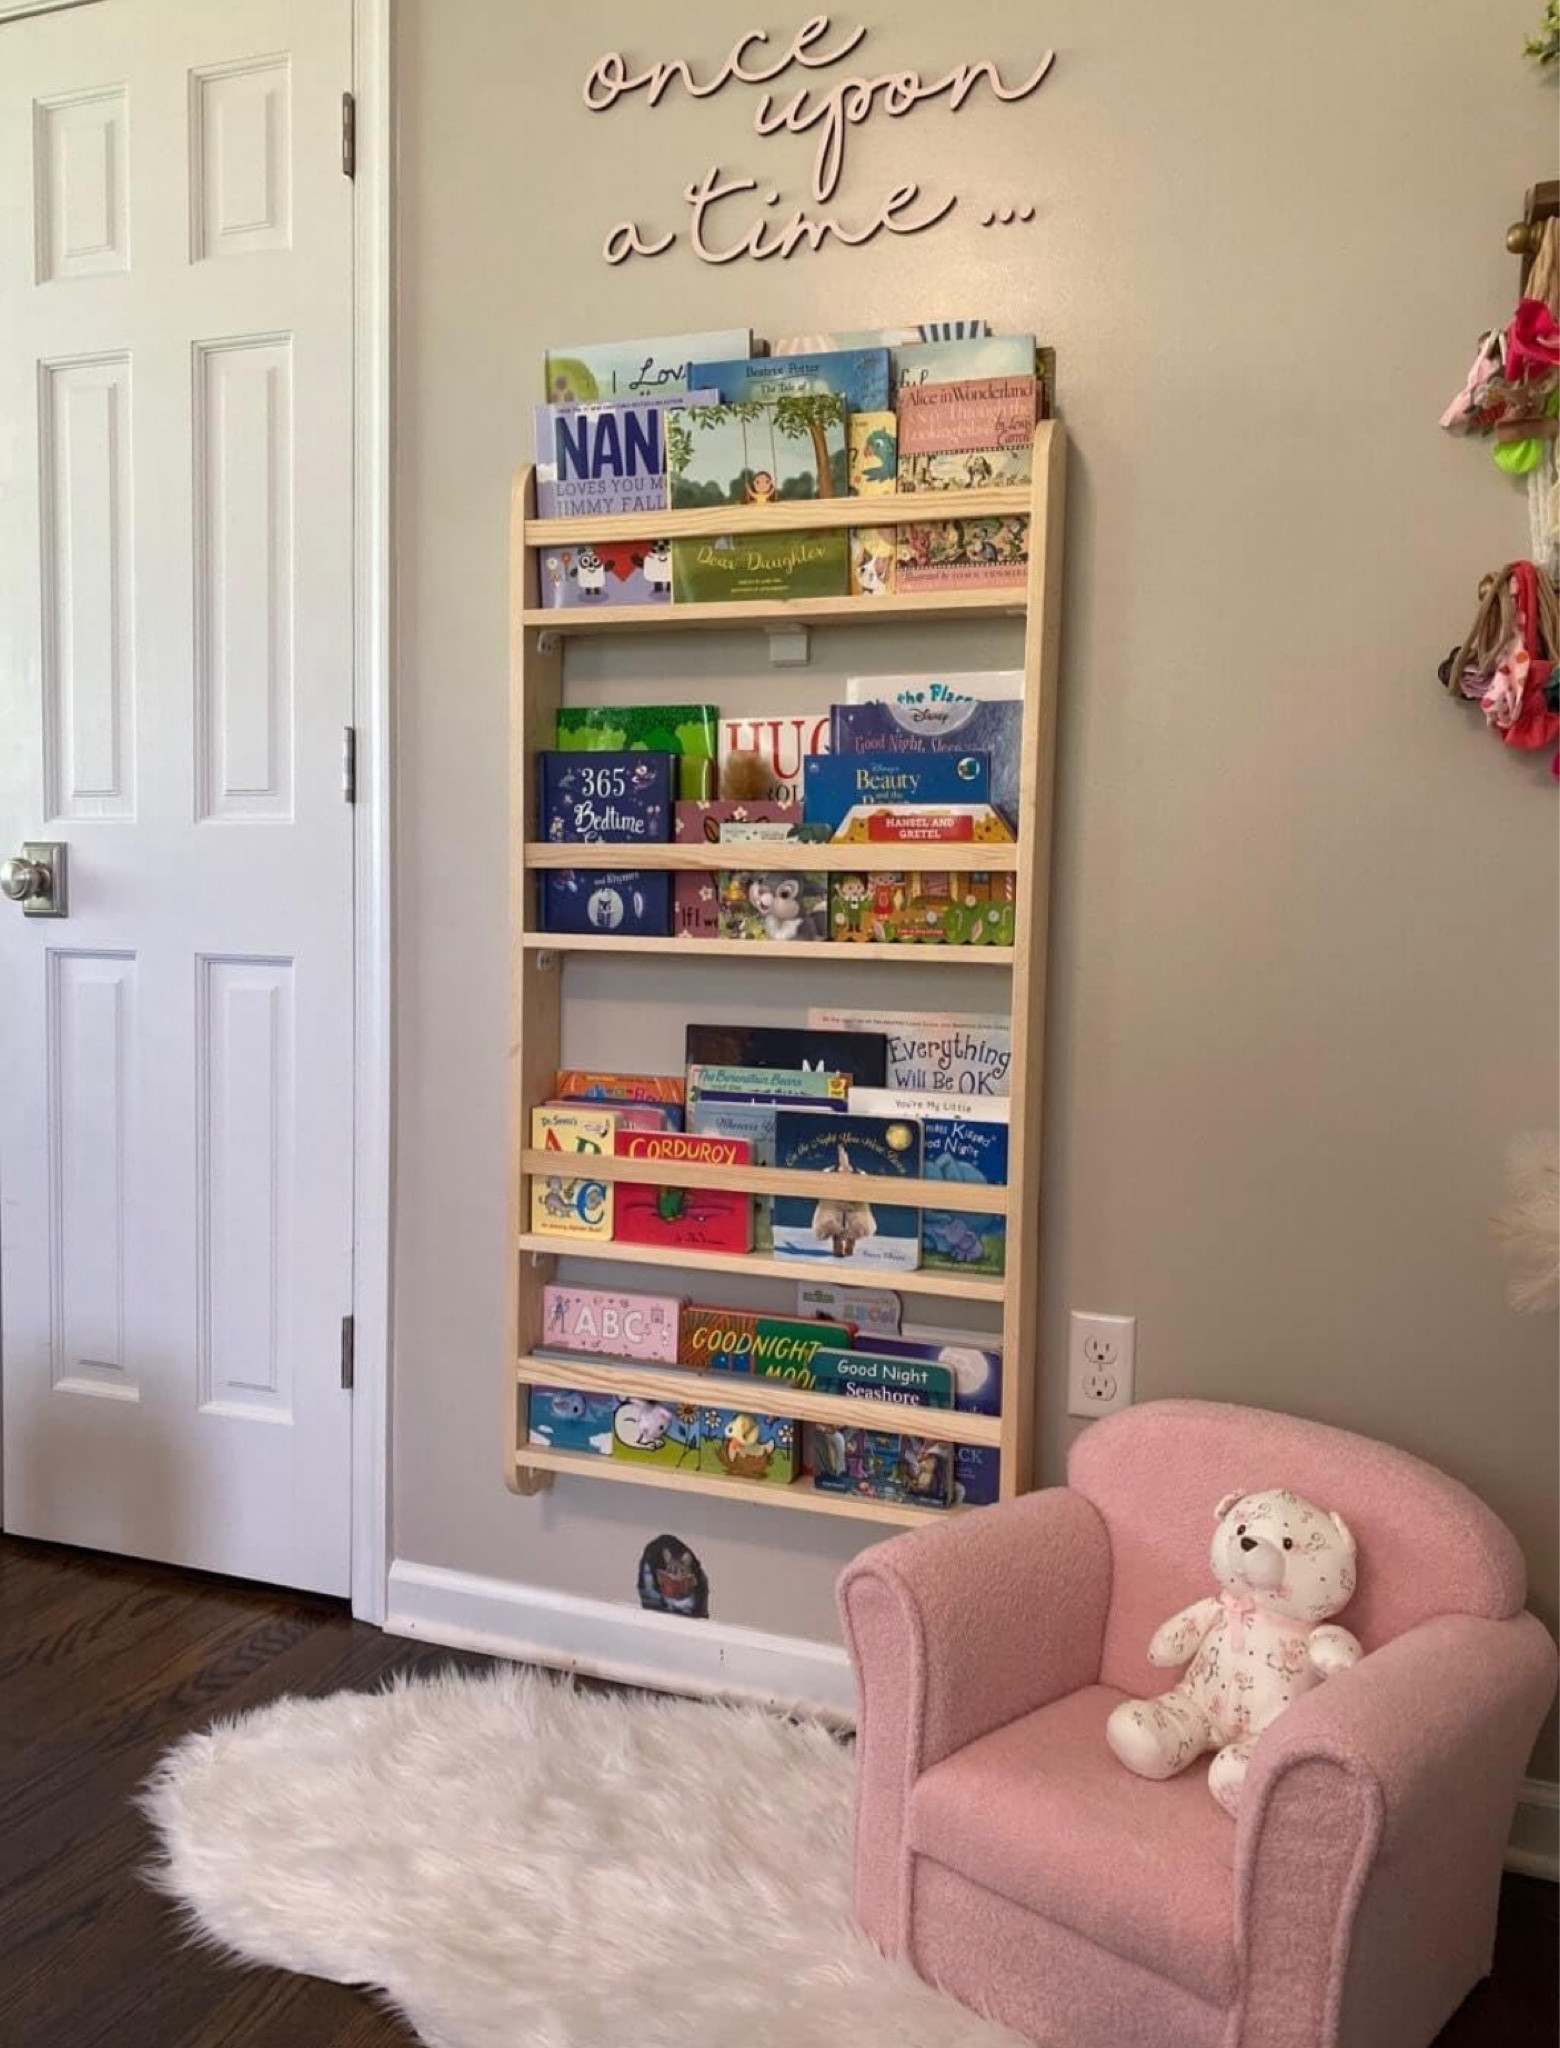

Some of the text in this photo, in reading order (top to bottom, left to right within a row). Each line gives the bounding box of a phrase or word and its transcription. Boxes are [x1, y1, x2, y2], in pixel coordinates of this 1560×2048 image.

[583, 15, 867, 111] once
[753, 49, 1056, 203] upon
[602, 220, 676, 265] a
[684, 166, 958, 264] time
[628, 357, 687, 390] Lov
[906, 379, 1034, 406] Alice in Wonderland
[555, 409, 668, 481] NAN
[556, 478, 667, 497] LOVES YOU M
[696, 543, 826, 574] Dear Daughter
[896, 691, 925, 704] the
[909, 708, 950, 725] Disney
[581, 768, 627, 799] 365
[856, 769, 921, 795] Beauty
[573, 800, 645, 834] Bedtime
[885, 818, 955, 828] HANSEL AND
[899, 829, 942, 840] GRETEL
[886, 1032, 1012, 1081] Everything
[894, 1068, 994, 1095] Will Be OK
[896, 1100, 972, 1113] You're My Little
[629, 1138, 737, 1165] CORDUROY
[575, 1181, 607, 1225] C
[693, 1327, 822, 1363] GOODNIGHT
[837, 1359, 929, 1386] Good Night
[846, 1382, 921, 1406] Seashore
